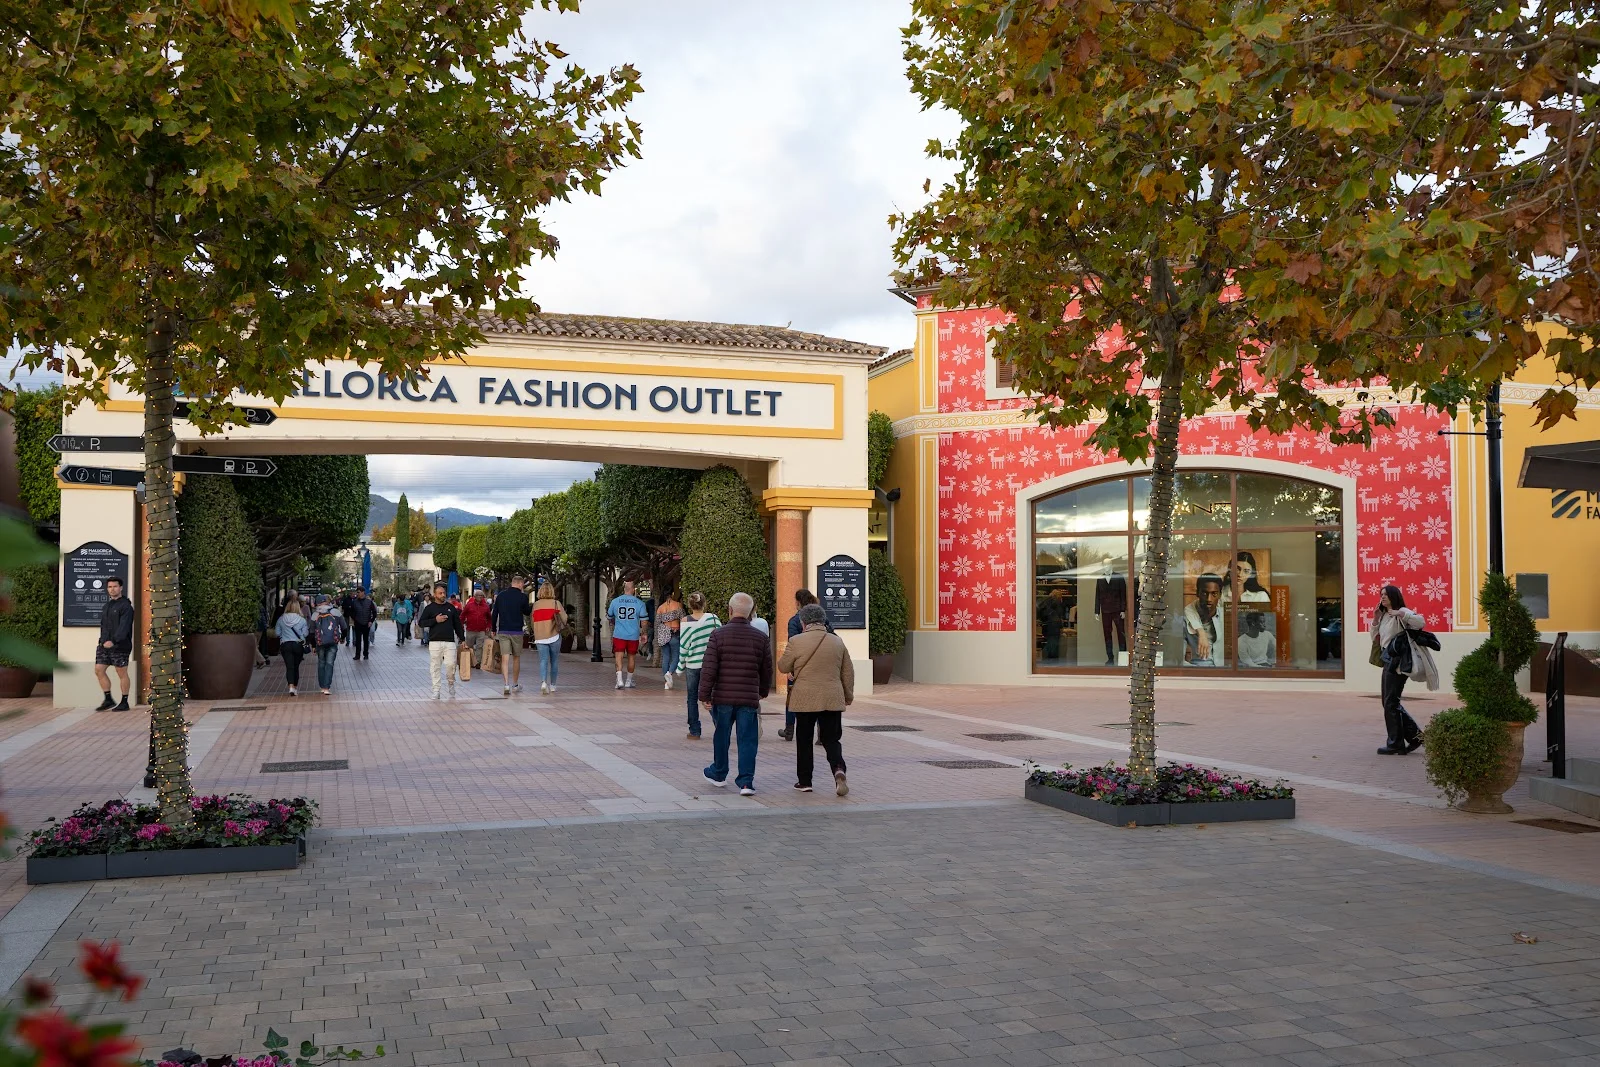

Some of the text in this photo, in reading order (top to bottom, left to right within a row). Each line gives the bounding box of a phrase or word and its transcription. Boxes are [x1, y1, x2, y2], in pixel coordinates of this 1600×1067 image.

[240, 368, 782, 417] LLORCA FASHION OUTLET
[618, 606, 636, 620] 92
